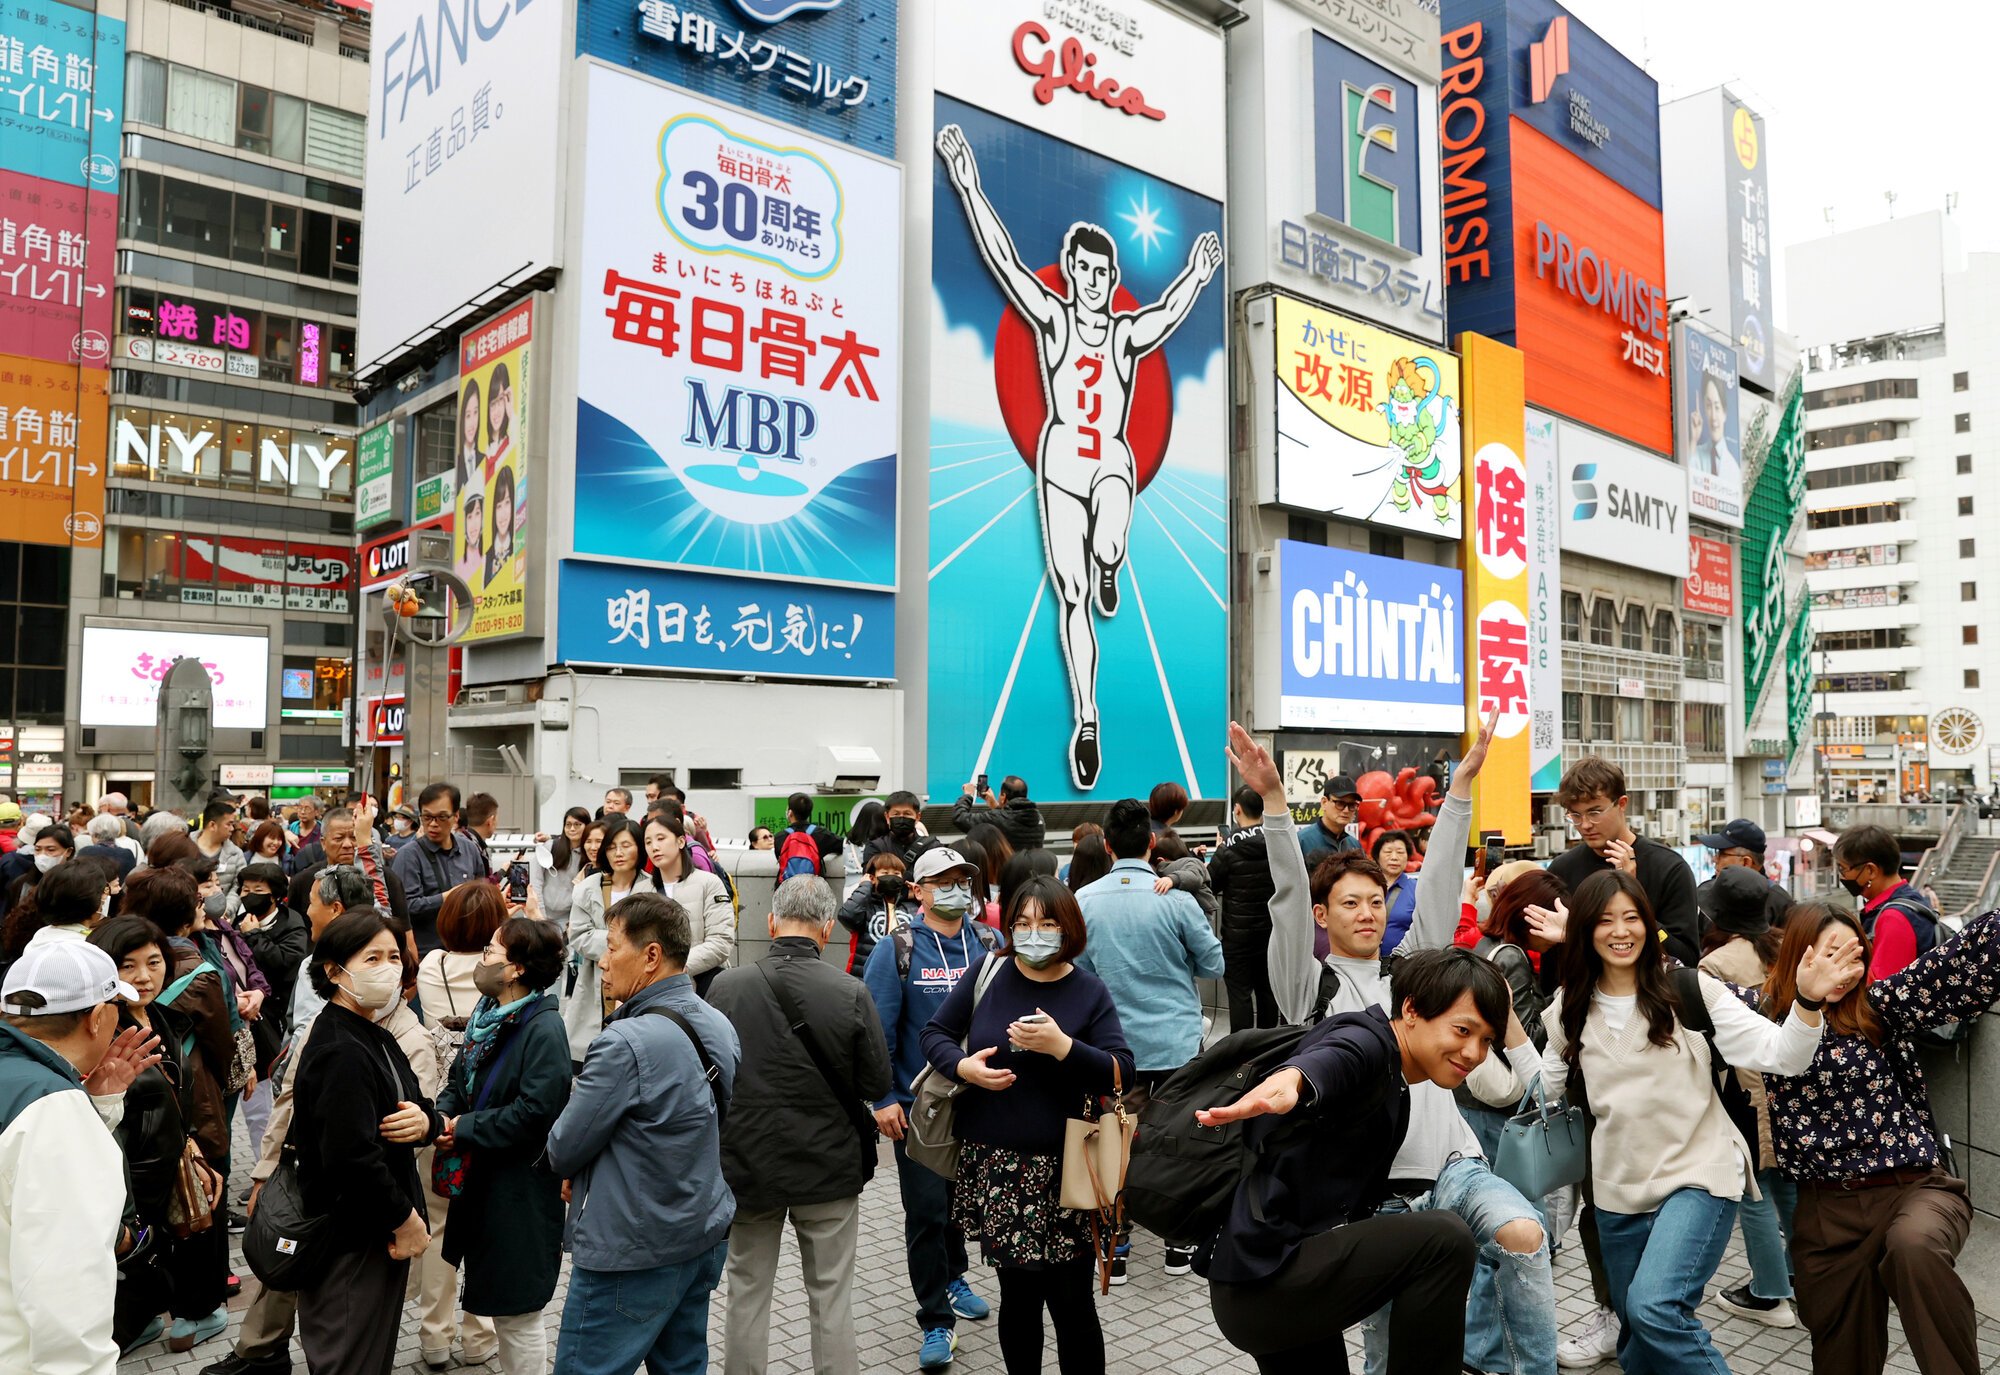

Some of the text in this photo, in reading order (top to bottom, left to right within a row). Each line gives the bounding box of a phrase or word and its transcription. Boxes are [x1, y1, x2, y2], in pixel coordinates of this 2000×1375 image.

[638, 0, 868, 106] 雪印メグミルク
[1311, 0, 1415, 60] ステムシリーズ
[381, 0, 533, 140] FAN
[1012, 21, 1166, 121] Glico
[404, 81, 503, 194] 正直品質。
[1570, 102, 1611, 141] CONSUMER
[1571, 116, 1603, 149] FINANCE
[83, 161, 115, 178] 生薬
[717, 153, 791, 195] 毎日骨太
[718, 144, 792, 174] まいにちほねぶと
[1440, 21, 1490, 290] PROMISE
[682, 170, 821, 242] 30 周年
[761, 230, 821, 258] ありがとう
[651, 251, 844, 319] まいにちほねぶと
[1282, 219, 1444, 320] 日商エステム
[1536, 219, 1665, 341] PROMISE
[129, 308, 150, 319] OPEN
[158, 300, 250, 350] 焼肉
[477, 311, 529, 360] 住宅情報館
[603, 268, 880, 402] 毎日骨太
[1302, 319, 1367, 363] かぜに
[1621, 330, 1665, 377] プロミス
[1074, 352, 1105, 461] グリコ
[1294, 351, 1374, 413] 改源
[682, 377, 818, 464] MBP
[117, 420, 348, 490] NY NY
[67, 519, 98, 533] 生薬
[1607, 483, 1677, 534] SAMTY
[287, 552, 344, 584] 風月
[1475, 459, 1529, 716] 検索
[183, 590, 214, 602] 営業時間
[482, 589, 523, 609] スタッフ大募集
[475, 614, 523, 634] 0120-951-820
[1443, 761, 1450, 789] 2F
